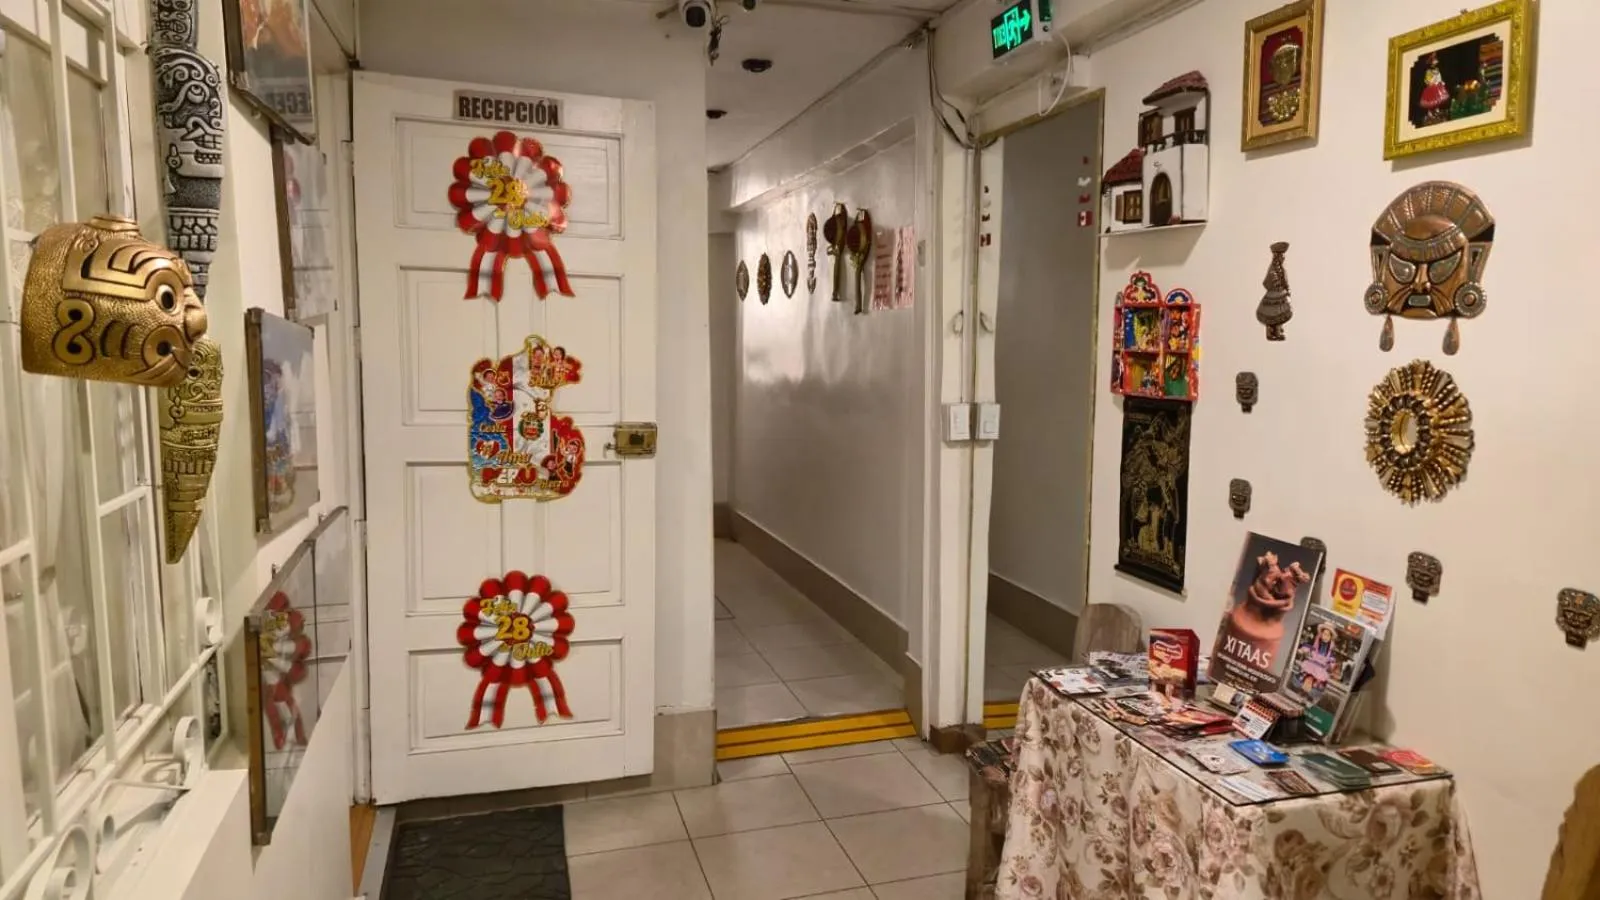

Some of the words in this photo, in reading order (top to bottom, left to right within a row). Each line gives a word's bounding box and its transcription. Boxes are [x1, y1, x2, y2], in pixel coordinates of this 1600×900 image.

[458, 95, 559, 127] RECEPCIÓN
[488, 180, 529, 207] 28
[496, 614, 531, 641] 28
